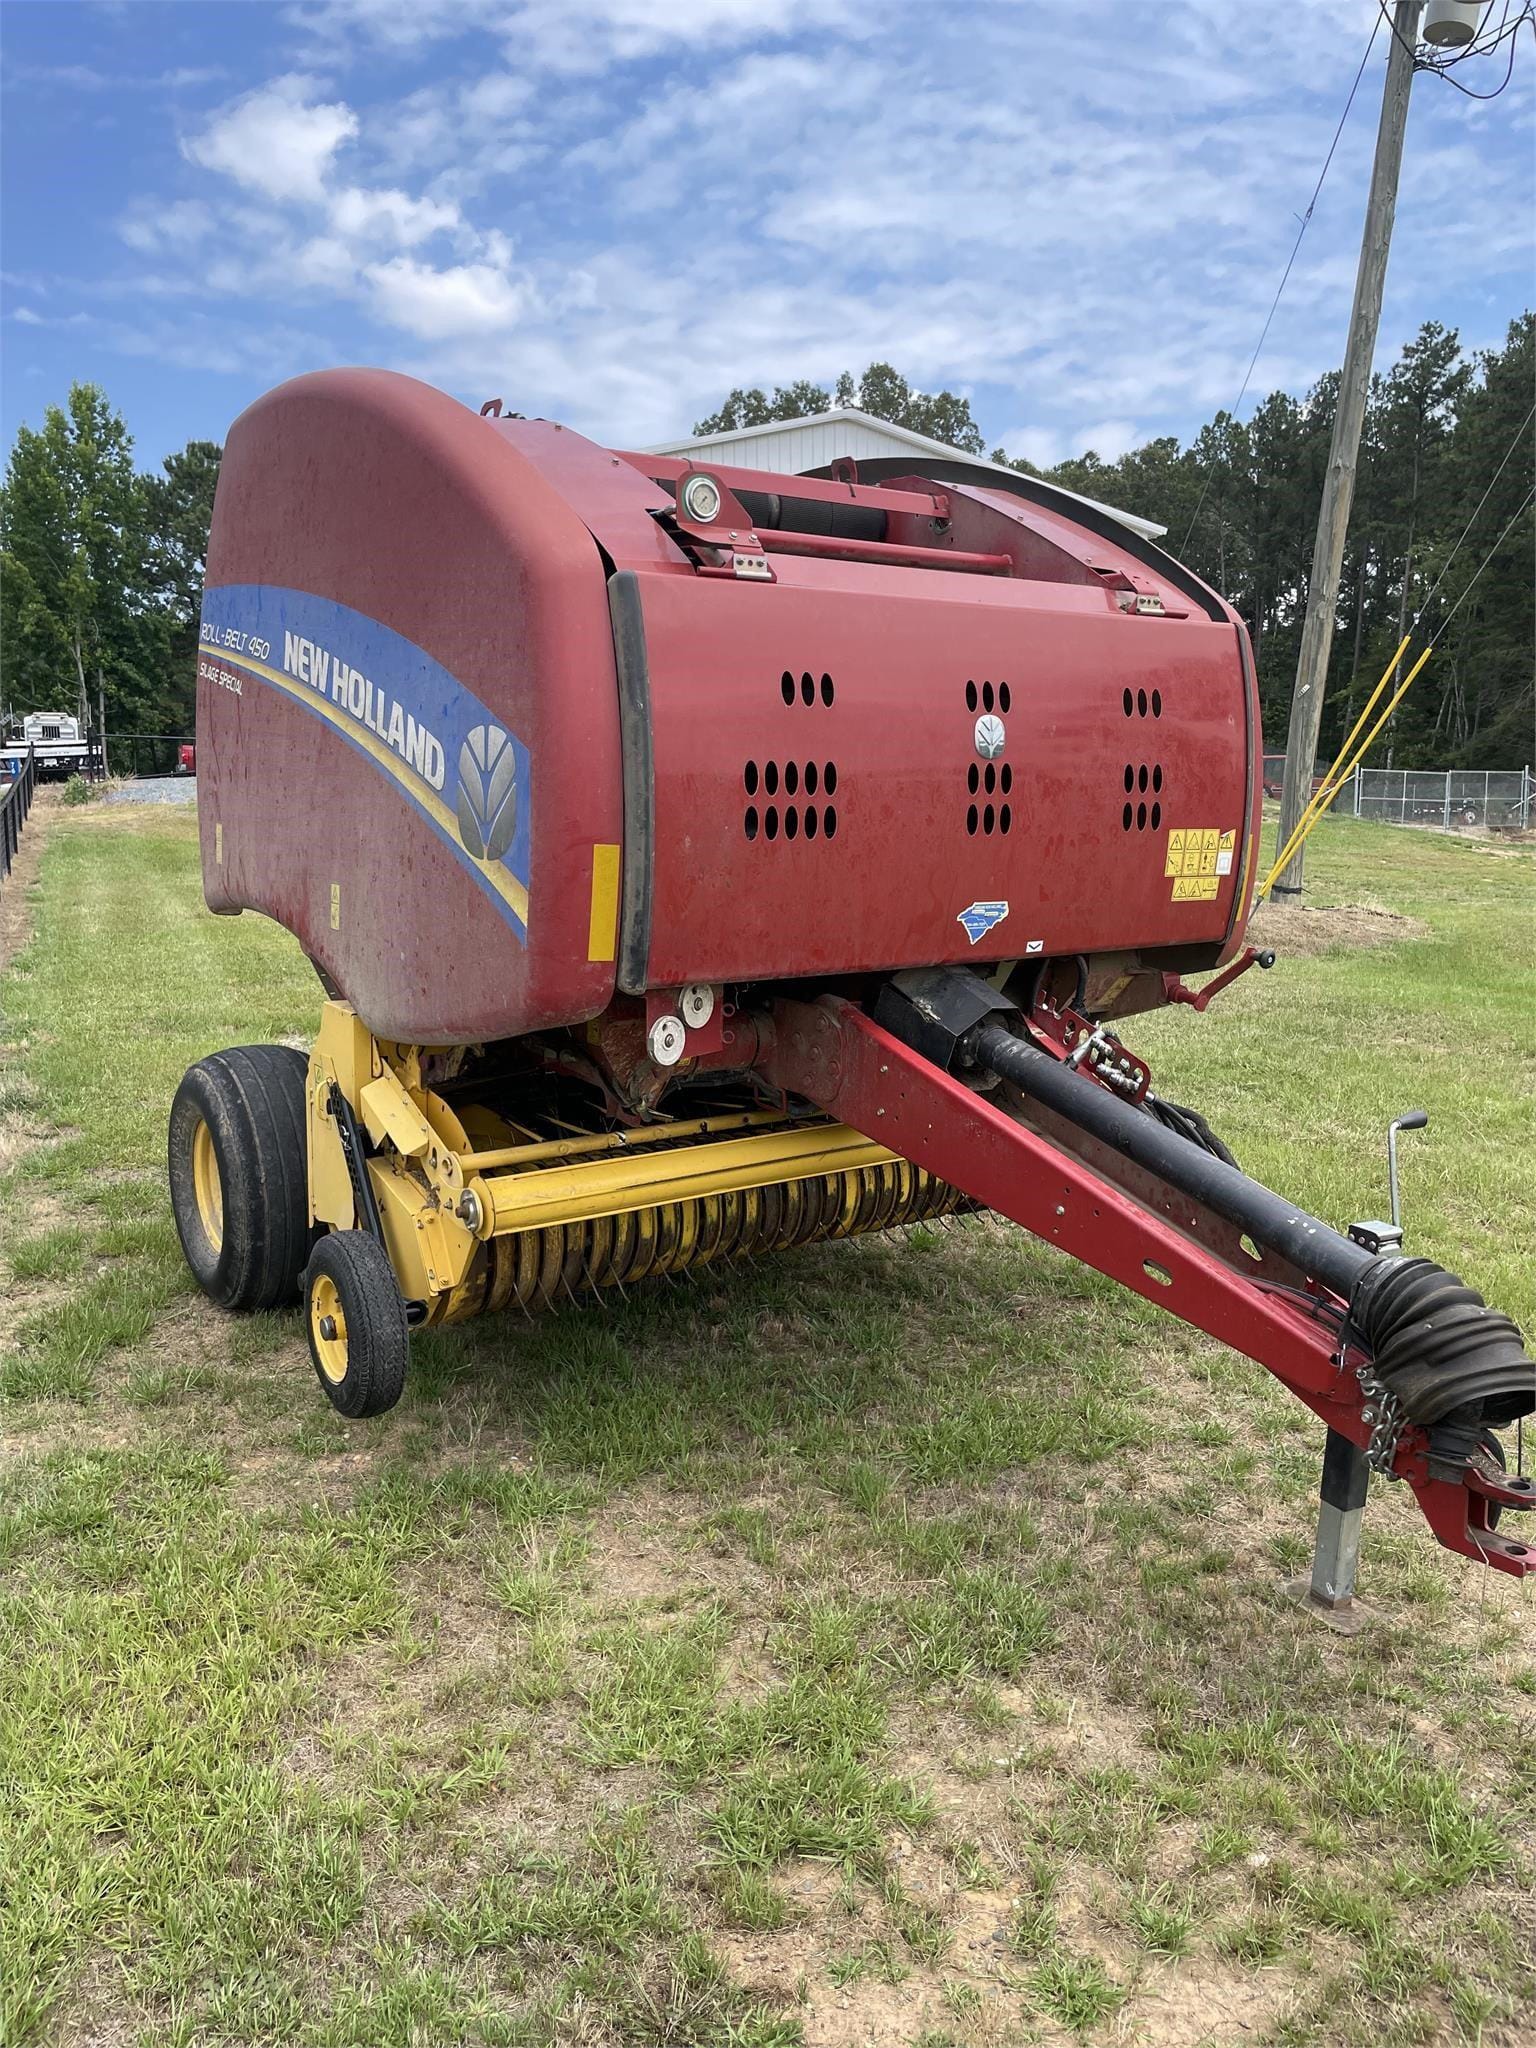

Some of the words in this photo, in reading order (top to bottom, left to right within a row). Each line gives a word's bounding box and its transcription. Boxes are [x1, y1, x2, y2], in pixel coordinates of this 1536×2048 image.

[201, 623, 248, 651] ROLL-BELT
[248, 636, 270, 660] 450
[218, 671, 243, 696] SPECIAL
[284, 631, 329, 693] NEW
[332, 657, 445, 791] HOLLAND
